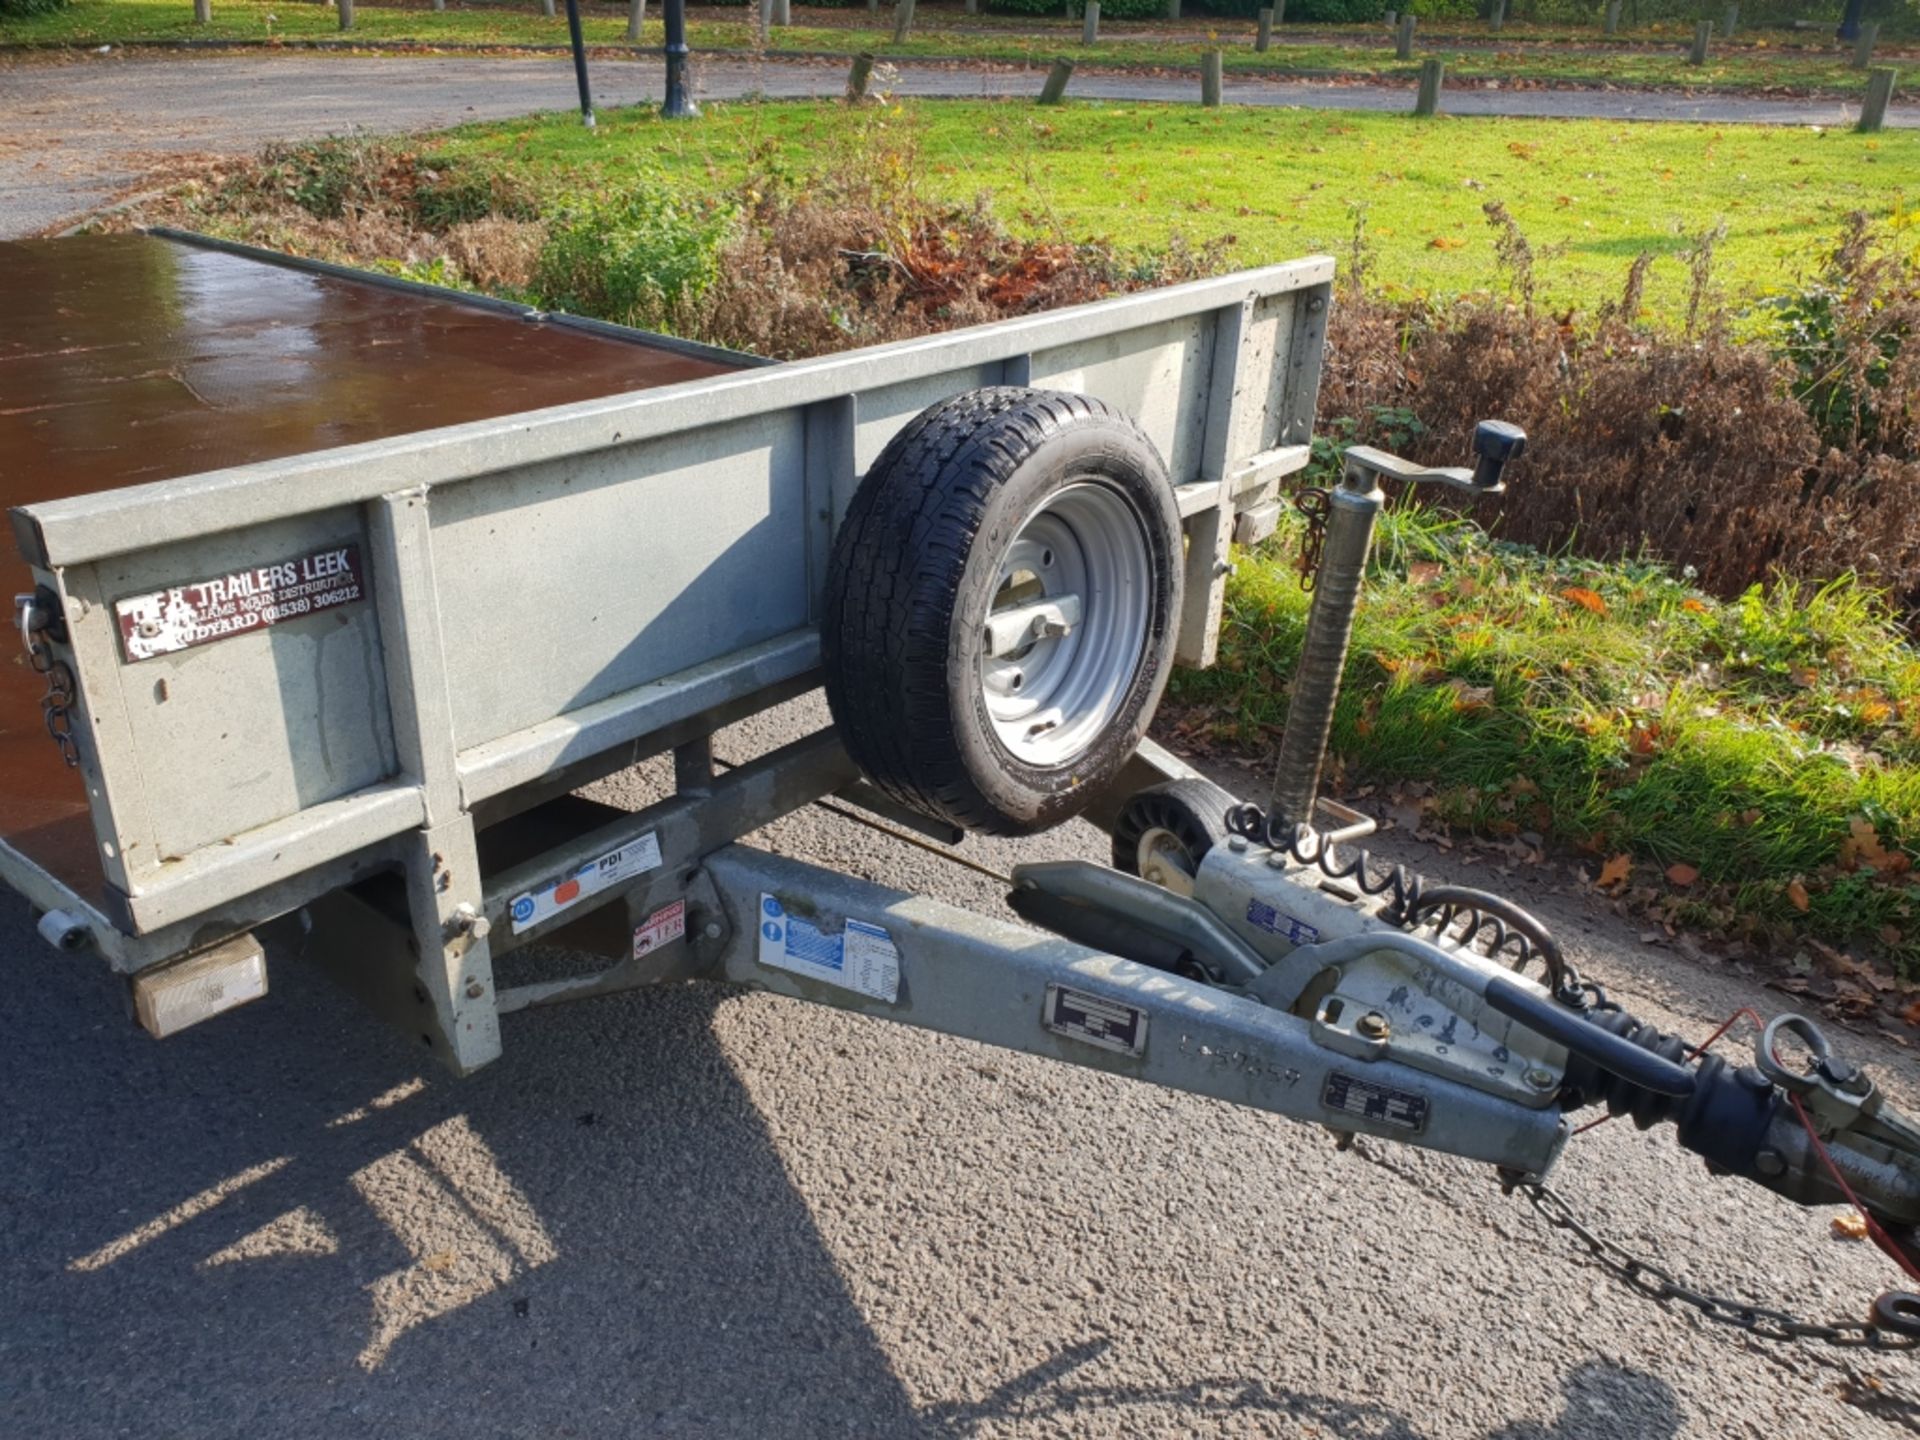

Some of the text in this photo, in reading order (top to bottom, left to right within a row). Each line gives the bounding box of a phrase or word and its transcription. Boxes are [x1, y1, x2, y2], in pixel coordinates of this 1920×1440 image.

[191, 562, 297, 607] TRAILERS
[302, 549, 351, 581] LEEK
[314, 585, 360, 609] 306212
[600, 851, 622, 871] PDI
